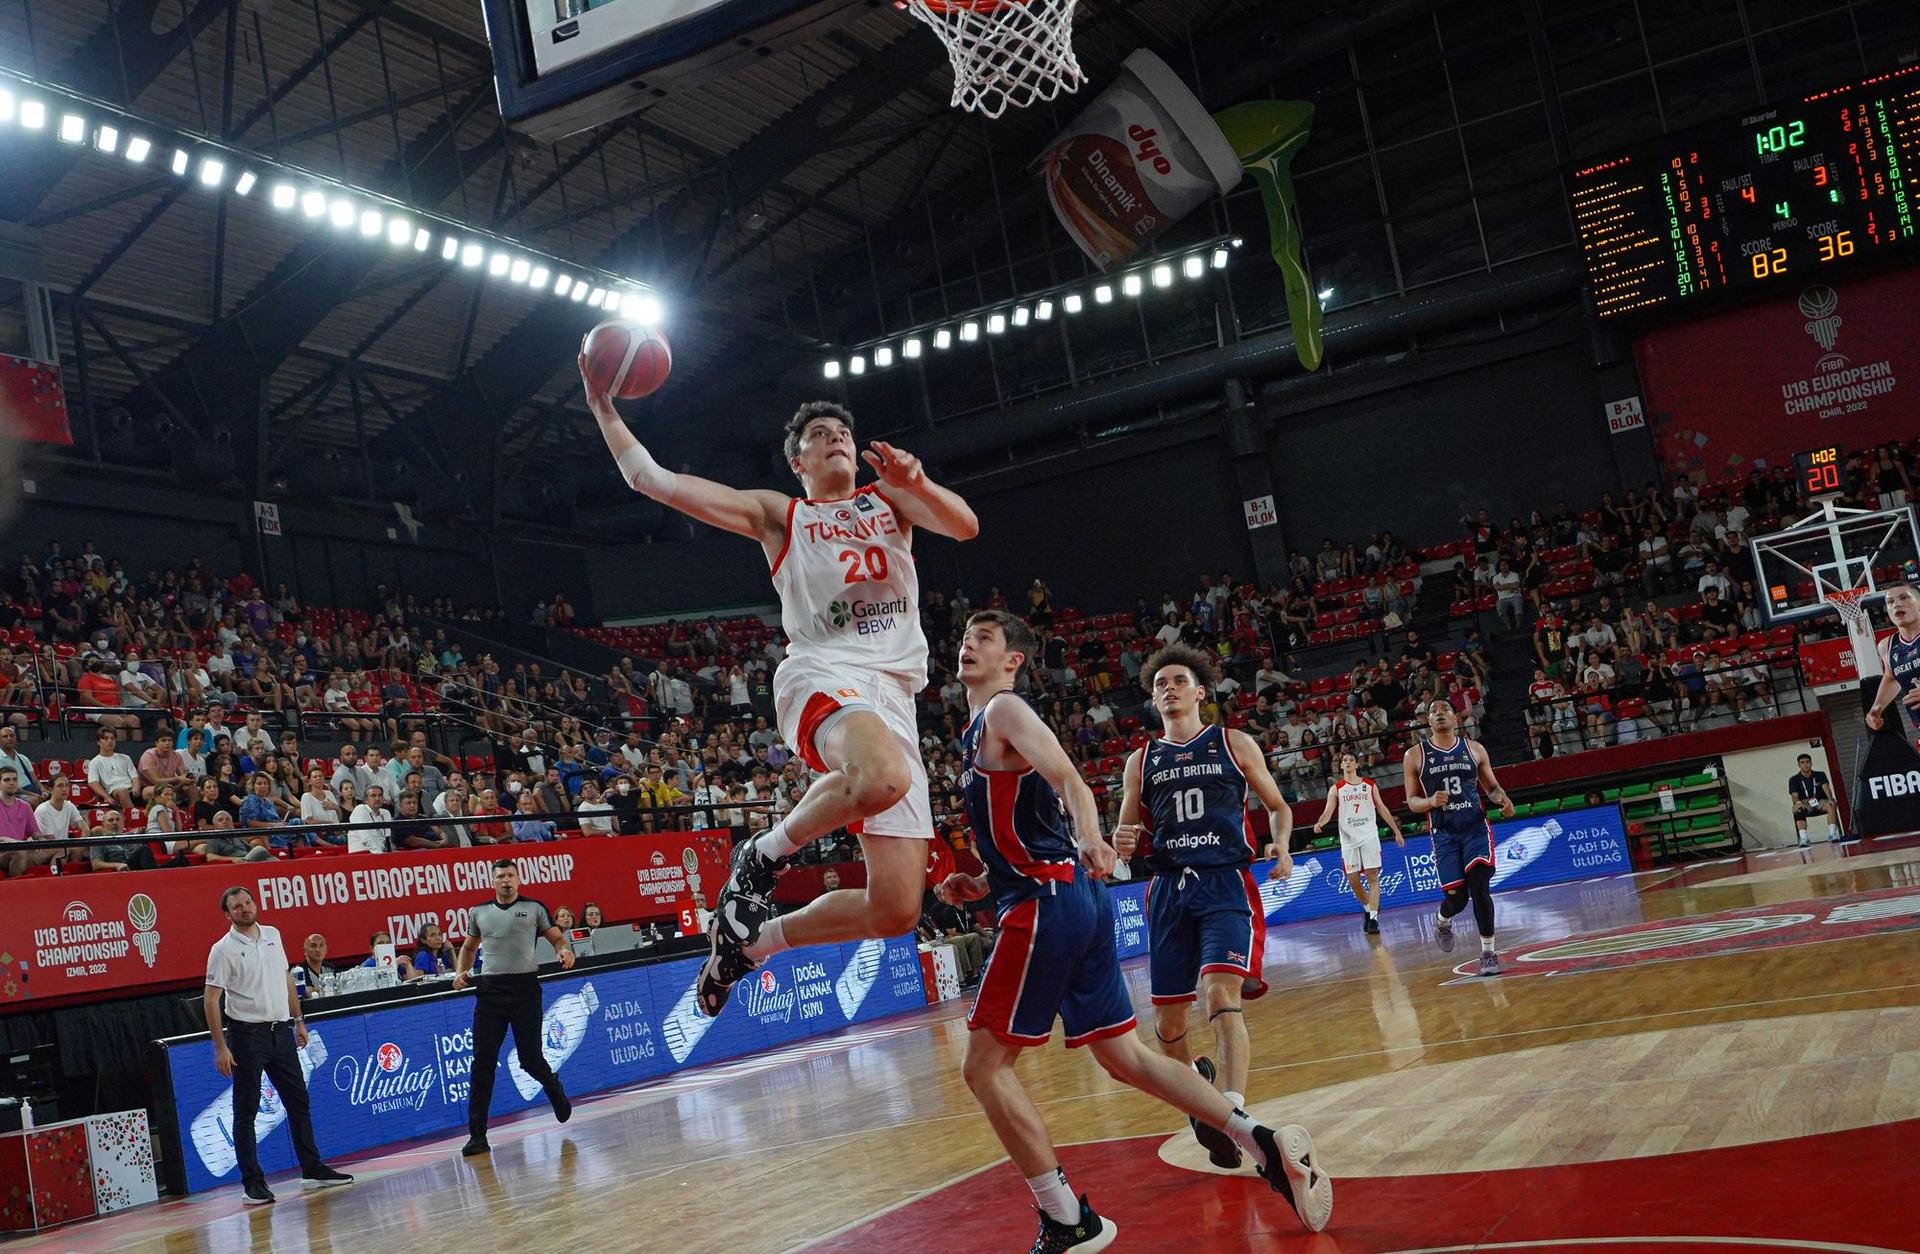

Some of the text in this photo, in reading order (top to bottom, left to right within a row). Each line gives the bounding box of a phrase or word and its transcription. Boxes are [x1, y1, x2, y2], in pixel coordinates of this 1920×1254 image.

[1842, 100, 1882, 120] 2 3 4
[1844, 121, 1851, 131] 2
[1878, 111, 1886, 122] 5
[1756, 120, 1804, 154] 1:02
[1864, 127, 1871, 138] 3
[1128, 124, 1171, 175] dyo
[1849, 143, 1856, 154] 2
[1870, 150, 1876, 160] 3
[1671, 158, 1681, 169] 10
[1690, 152, 1697, 163] 2
[1759, 154, 1780, 166] TIME
[1793, 153, 1825, 172] FAUL/SET
[1088, 148, 1136, 212] Dinamik
[1661, 168, 1684, 184] 3 4
[1722, 174, 1752, 192] FAUL/SET
[1814, 166, 1826, 186] 3
[1663, 186, 1670, 194] 4
[1680, 180, 1686, 190] 5
[1742, 186, 1755, 203] 4
[1860, 189, 1868, 200] 3
[1877, 184, 1885, 195] 2
[1665, 190, 1689, 206] 5 10
[1684, 202, 1692, 212] 2
[1701, 197, 1708, 208] 3
[1671, 208, 1710, 228] 9 2
[1776, 201, 1790, 218] 4
[1671, 223, 1696, 239] 10 10
[1772, 218, 1798, 232] PERIOD
[1806, 220, 1839, 239] SCORE
[1868, 224, 1876, 234] 2
[1889, 230, 1896, 240] 3
[1711, 241, 1718, 252] 2
[1741, 238, 1773, 256] SCORE
[1818, 230, 1854, 262] 36
[1752, 248, 1787, 278] 82
[1678, 273, 1690, 284] 20
[1680, 284, 1693, 296] 21
[1821, 359, 1844, 372] FIBA
[1782, 360, 1892, 399] U18 EUROPEAN
[1784, 376, 1896, 416] CHAMPIONSHIP
[1614, 400, 1632, 415] B-1
[1846, 400, 1868, 412] 2022
[1610, 413, 1642, 430] BLOK
[1812, 448, 1836, 464] 1:02
[1808, 464, 1839, 491] 20
[1251, 499, 1267, 512] B-1
[1248, 512, 1275, 525] BLOK
[839, 546, 888, 584] 20
[852, 597, 907, 618] Garanti
[857, 618, 896, 635] BBVA
[1152, 764, 1222, 785] GREAT BRITAIN
[1430, 765, 1448, 774] GREAT
[1443, 776, 1462, 795] 13
[1869, 770, 1920, 799] FIBA
[1172, 787, 1205, 823] 10
[1354, 804, 1360, 813] 7
[1568, 827, 1610, 841] ADI DA
[1569, 839, 1619, 855] TADI DA
[1572, 850, 1622, 868] ULUDAĞ
[637, 866, 683, 882] U18 EUROPEAN
[1414, 865, 1437, 878] KAY
[258, 854, 574, 910] FIBA U18 EUROPEAN CHAONSHIP
[639, 880, 685, 896] CHAMPIONSHIP
[68, 909, 88, 922] FIBA
[446, 907, 474, 938] 20
[682, 910, 692, 926] 5
[34, 920, 125, 947] U18 EUROPEAN
[36, 940, 129, 968] CHAMPIONSHIP
[89, 963, 107, 975] 2022
[796, 962, 826, 982] DOĞAL
[800, 980, 832, 1000] KAYNAK
[737, 978, 796, 1024] Uludağ
[802, 1000, 823, 1019] SUYU
[605, 1000, 642, 1021] ADI DA
[607, 1021, 652, 1043] TADI DA
[441, 1028, 473, 1055] DOĞ
[610, 1038, 655, 1065] ULUDAĞ
[445, 1055, 475, 1079] KAY
[334, 1055, 437, 1110] Uludağ
[371, 1096, 413, 1115] PREMIUM
